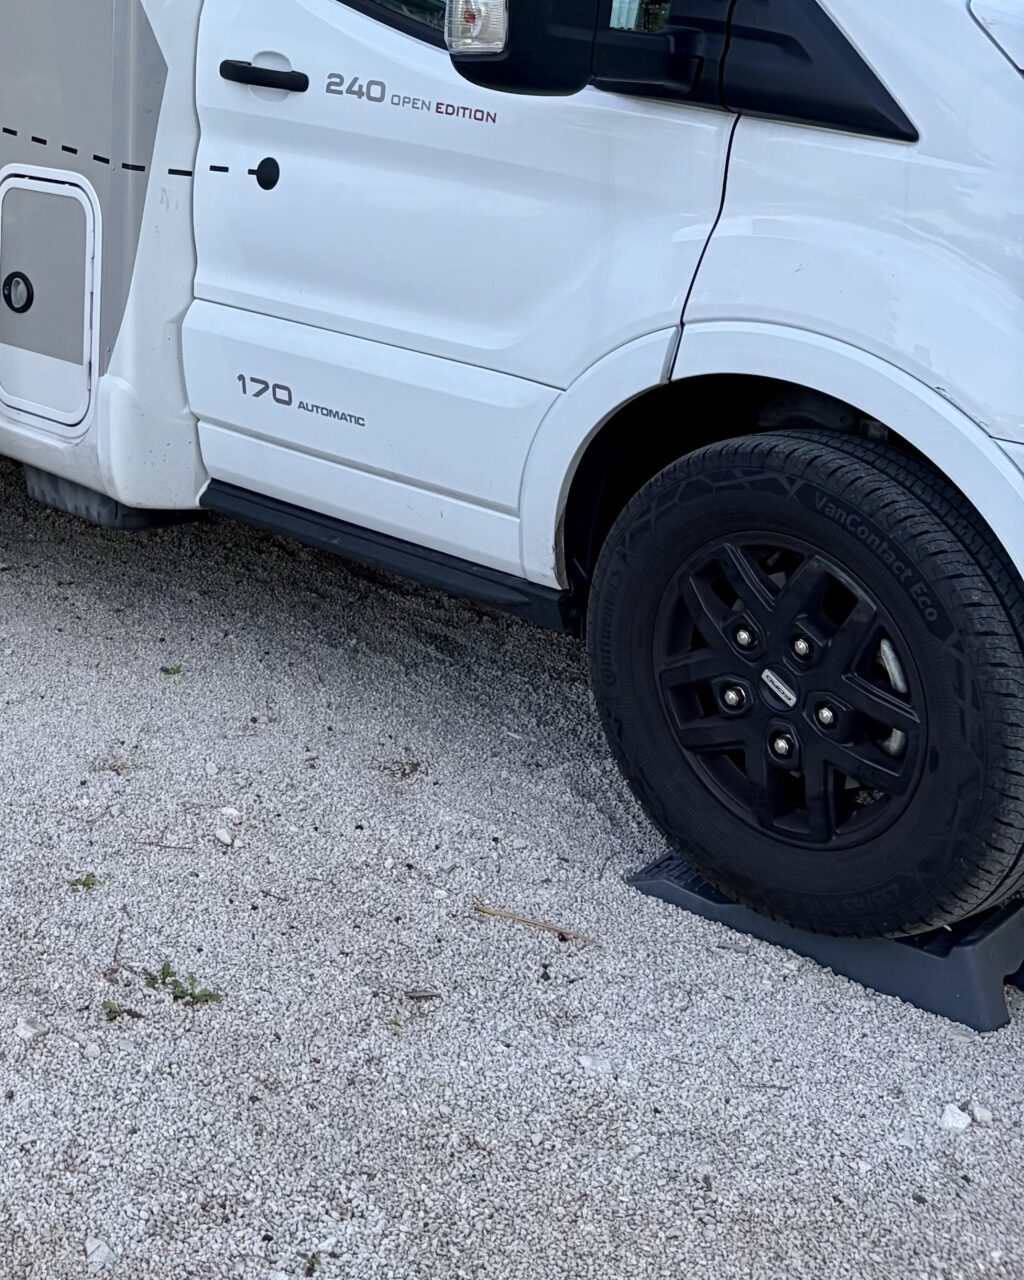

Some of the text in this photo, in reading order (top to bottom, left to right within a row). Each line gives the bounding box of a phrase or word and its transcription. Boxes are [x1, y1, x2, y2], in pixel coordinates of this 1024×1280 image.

[325, 73, 498, 124] 240 OPEN EDITION
[237, 373, 366, 428] 170 AUTOMATIC
[814, 491, 939, 623] VanContact Eco
